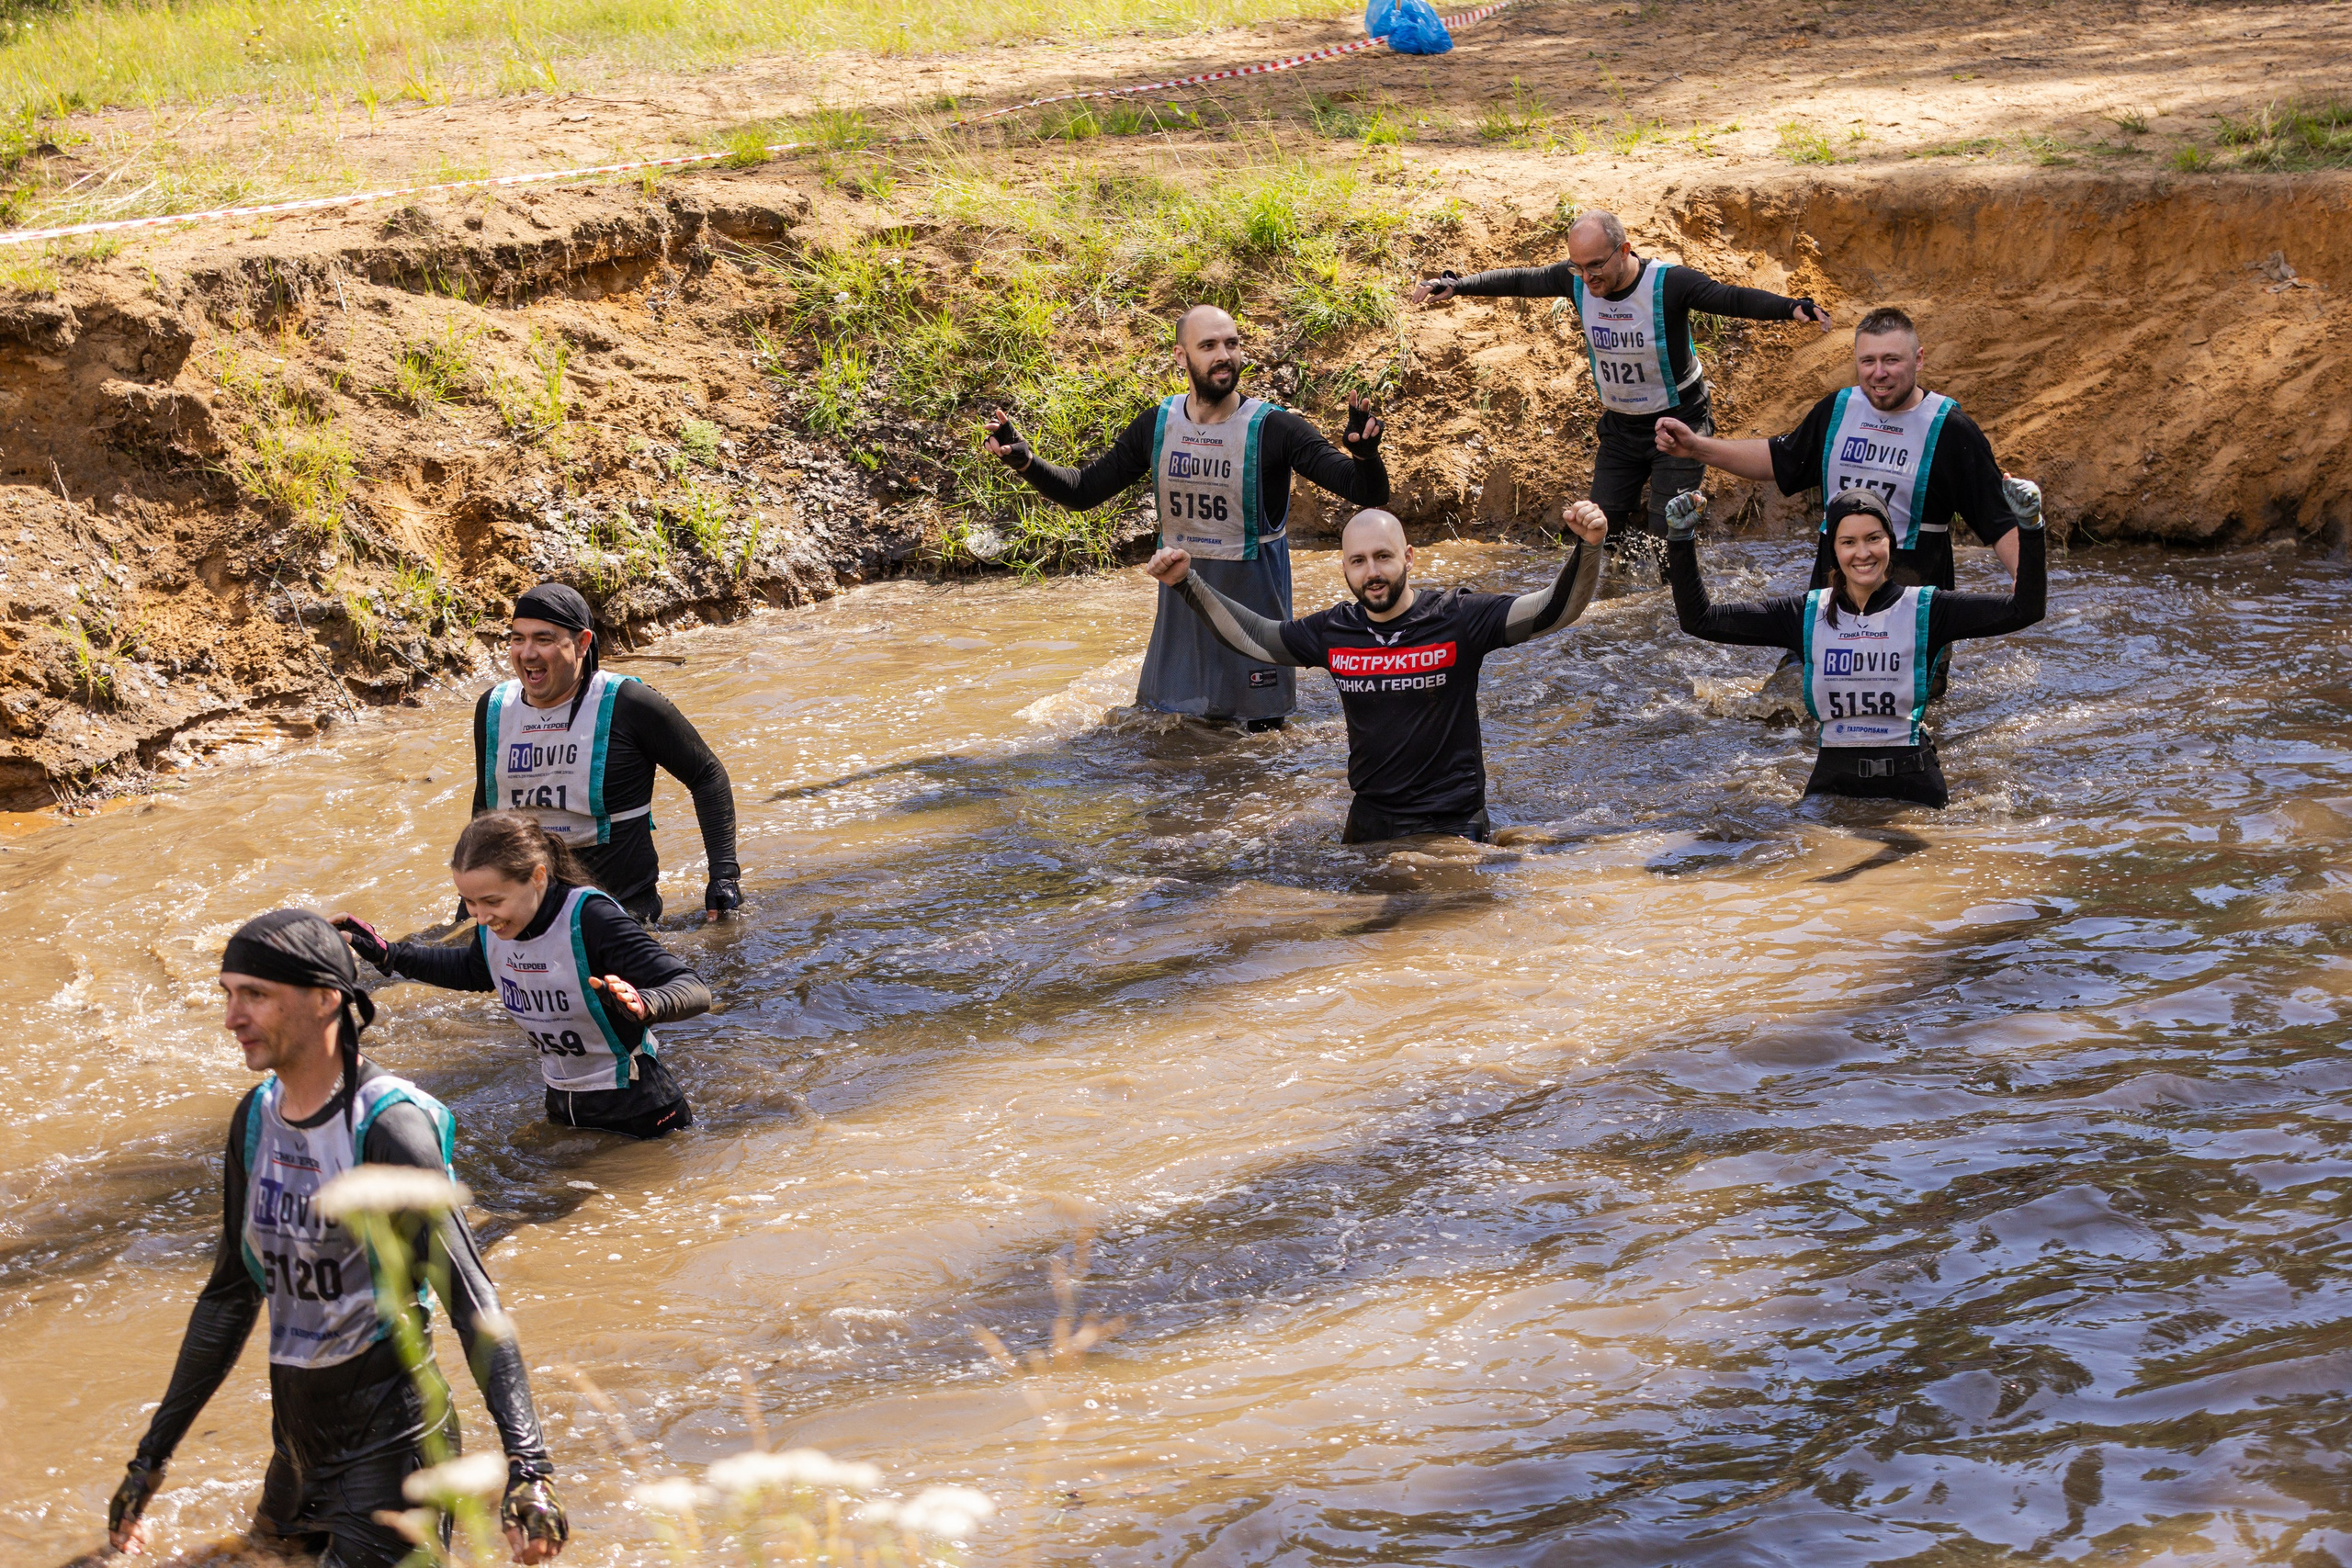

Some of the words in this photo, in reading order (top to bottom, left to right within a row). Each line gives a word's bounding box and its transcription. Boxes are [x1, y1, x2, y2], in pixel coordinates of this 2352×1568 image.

[1593, 329, 1645, 348] RODVIG
[1600, 360, 1645, 384] 6121
[1880, 424, 1904, 433] ГЕРОЕВ
[1842, 440, 1908, 467] RODVIG
[1170, 454, 1231, 479] RODVIG
[1169, 491, 1228, 522] 5156
[1332, 649, 1447, 671] ИНСТРУКТОР
[1826, 651, 1901, 673] RODVIG
[1382, 673, 1447, 691] ГЕРОЕВ
[1828, 692, 1896, 719] 5158
[1847, 726, 1889, 734] ГАЗПРОМБАНК
[509, 743, 578, 769] RODVIG
[503, 981, 570, 1012] RODVIG
